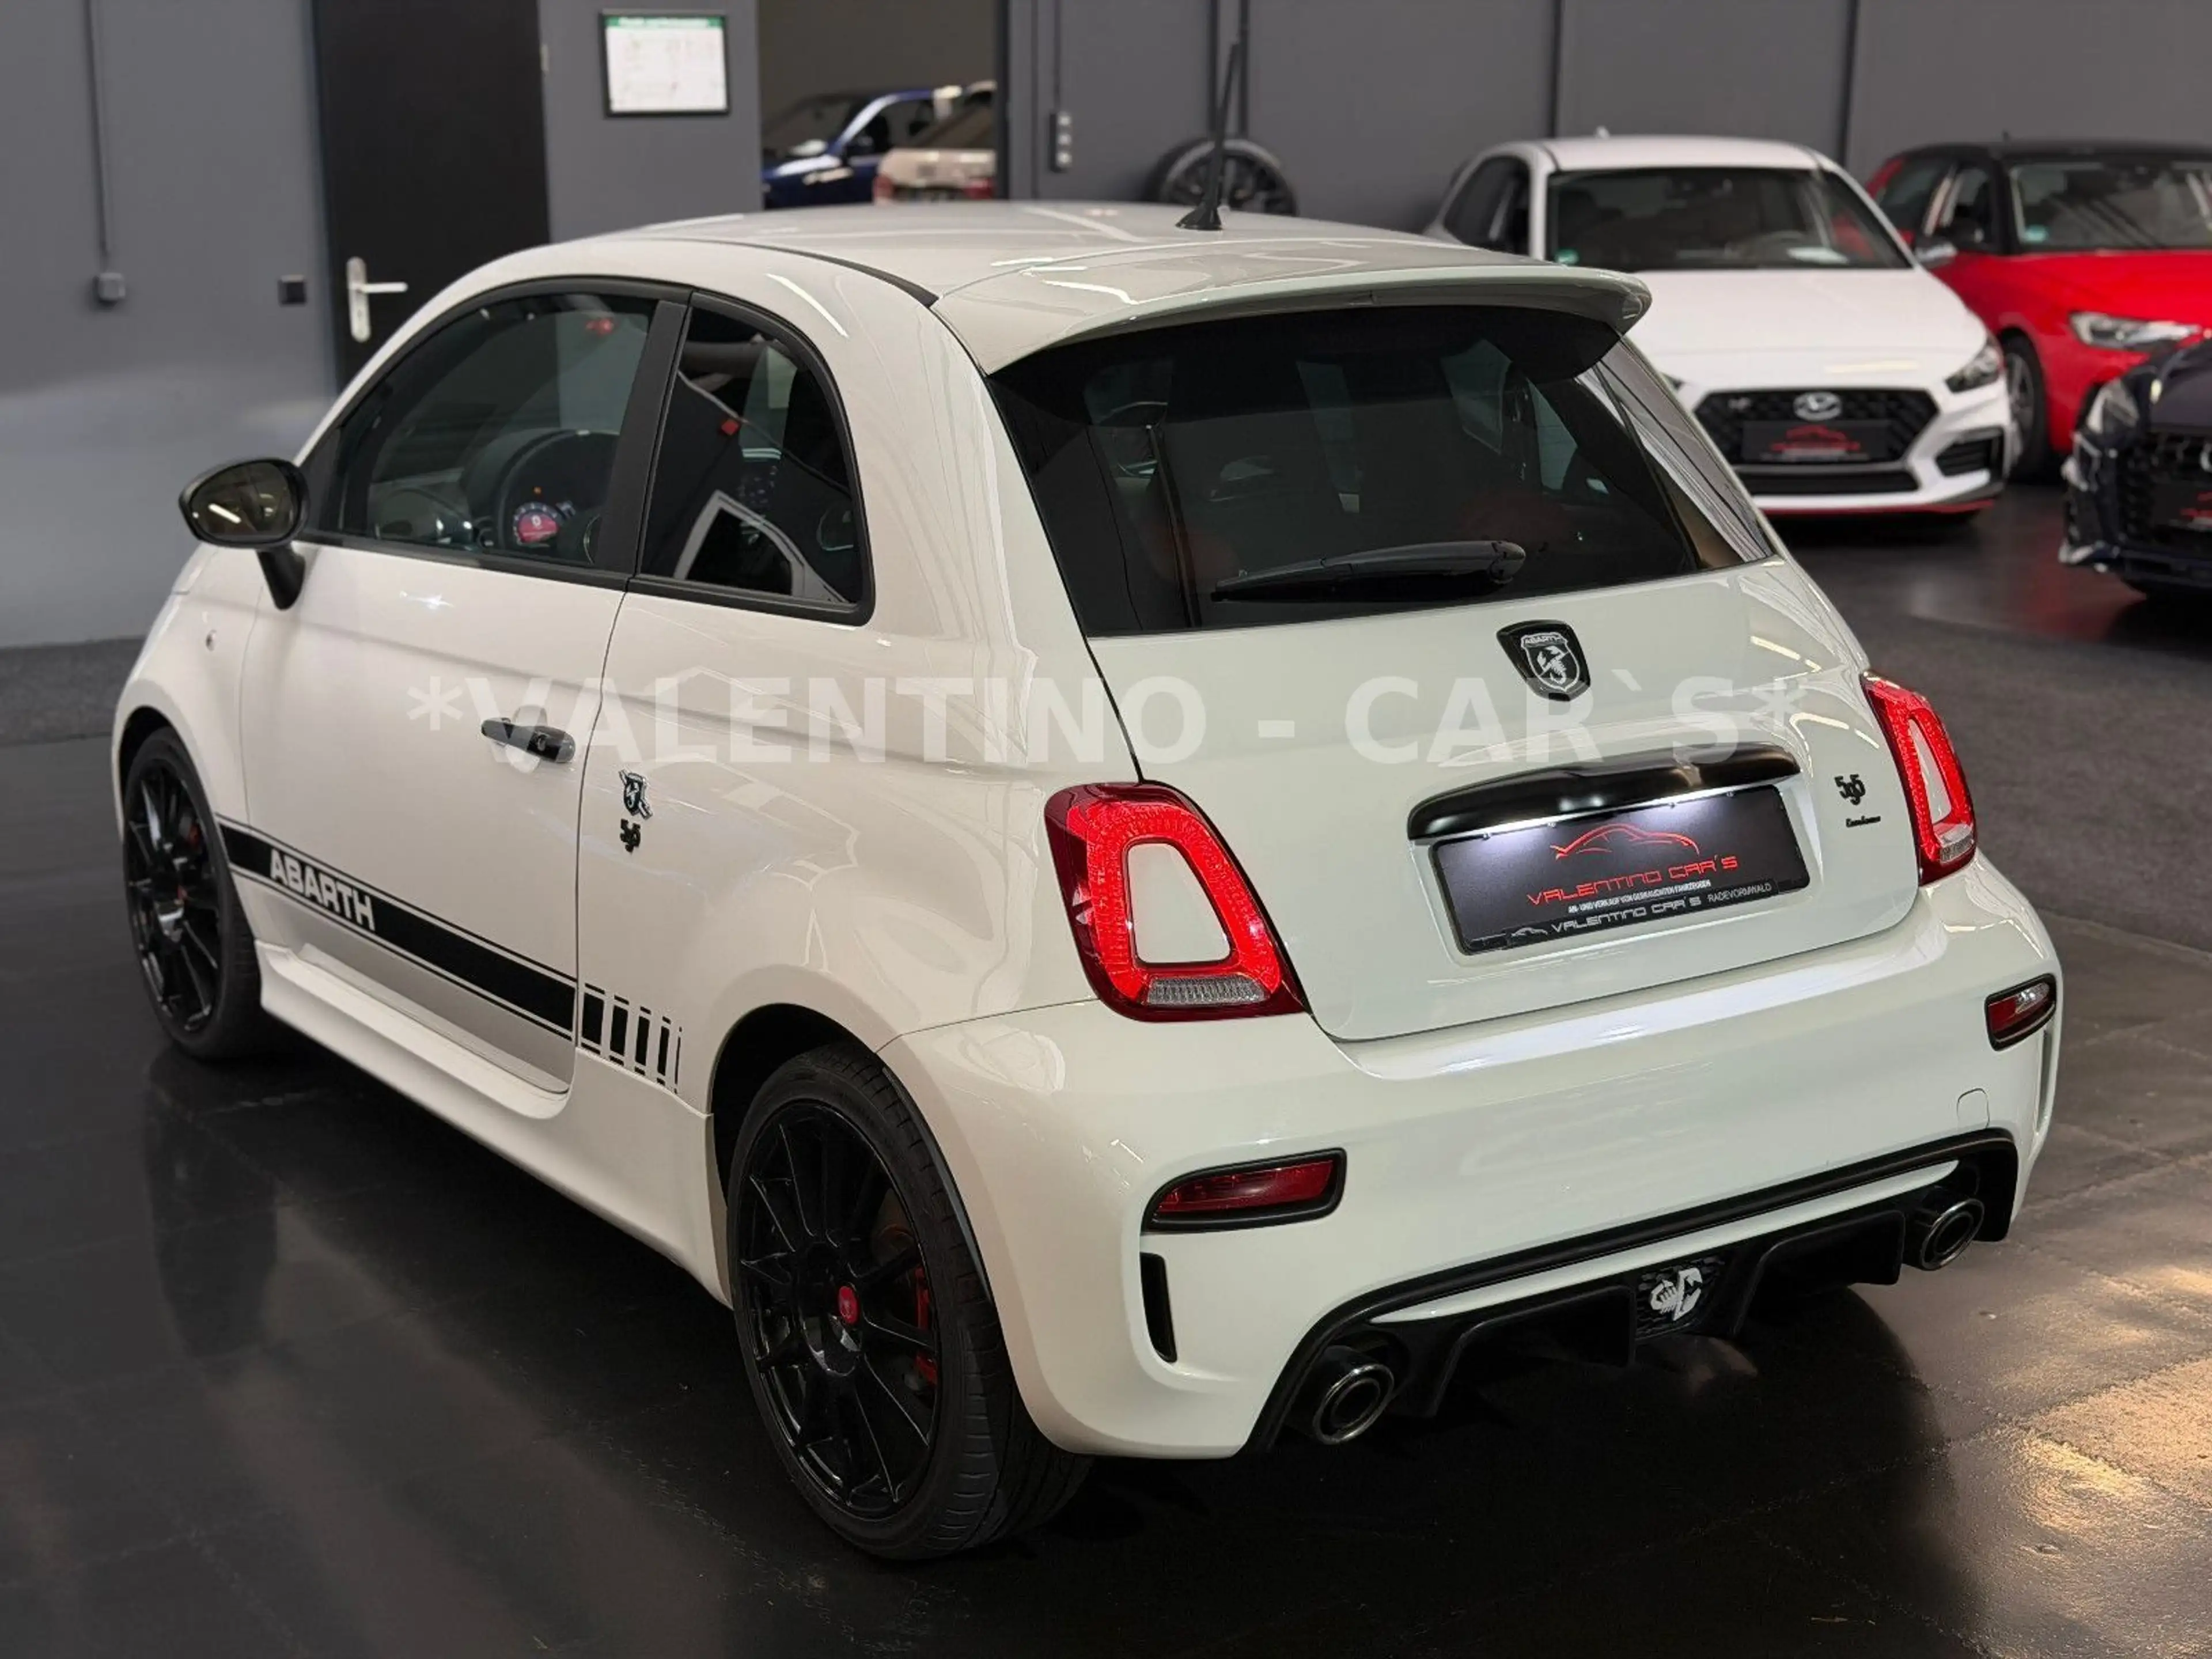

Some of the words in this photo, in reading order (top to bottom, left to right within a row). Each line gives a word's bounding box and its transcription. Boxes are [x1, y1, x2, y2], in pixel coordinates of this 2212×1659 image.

[270, 848, 376, 931] ABARTH
[1527, 870, 1662, 905] VALENTINO
[1551, 907, 1646, 933] VALENTINO
